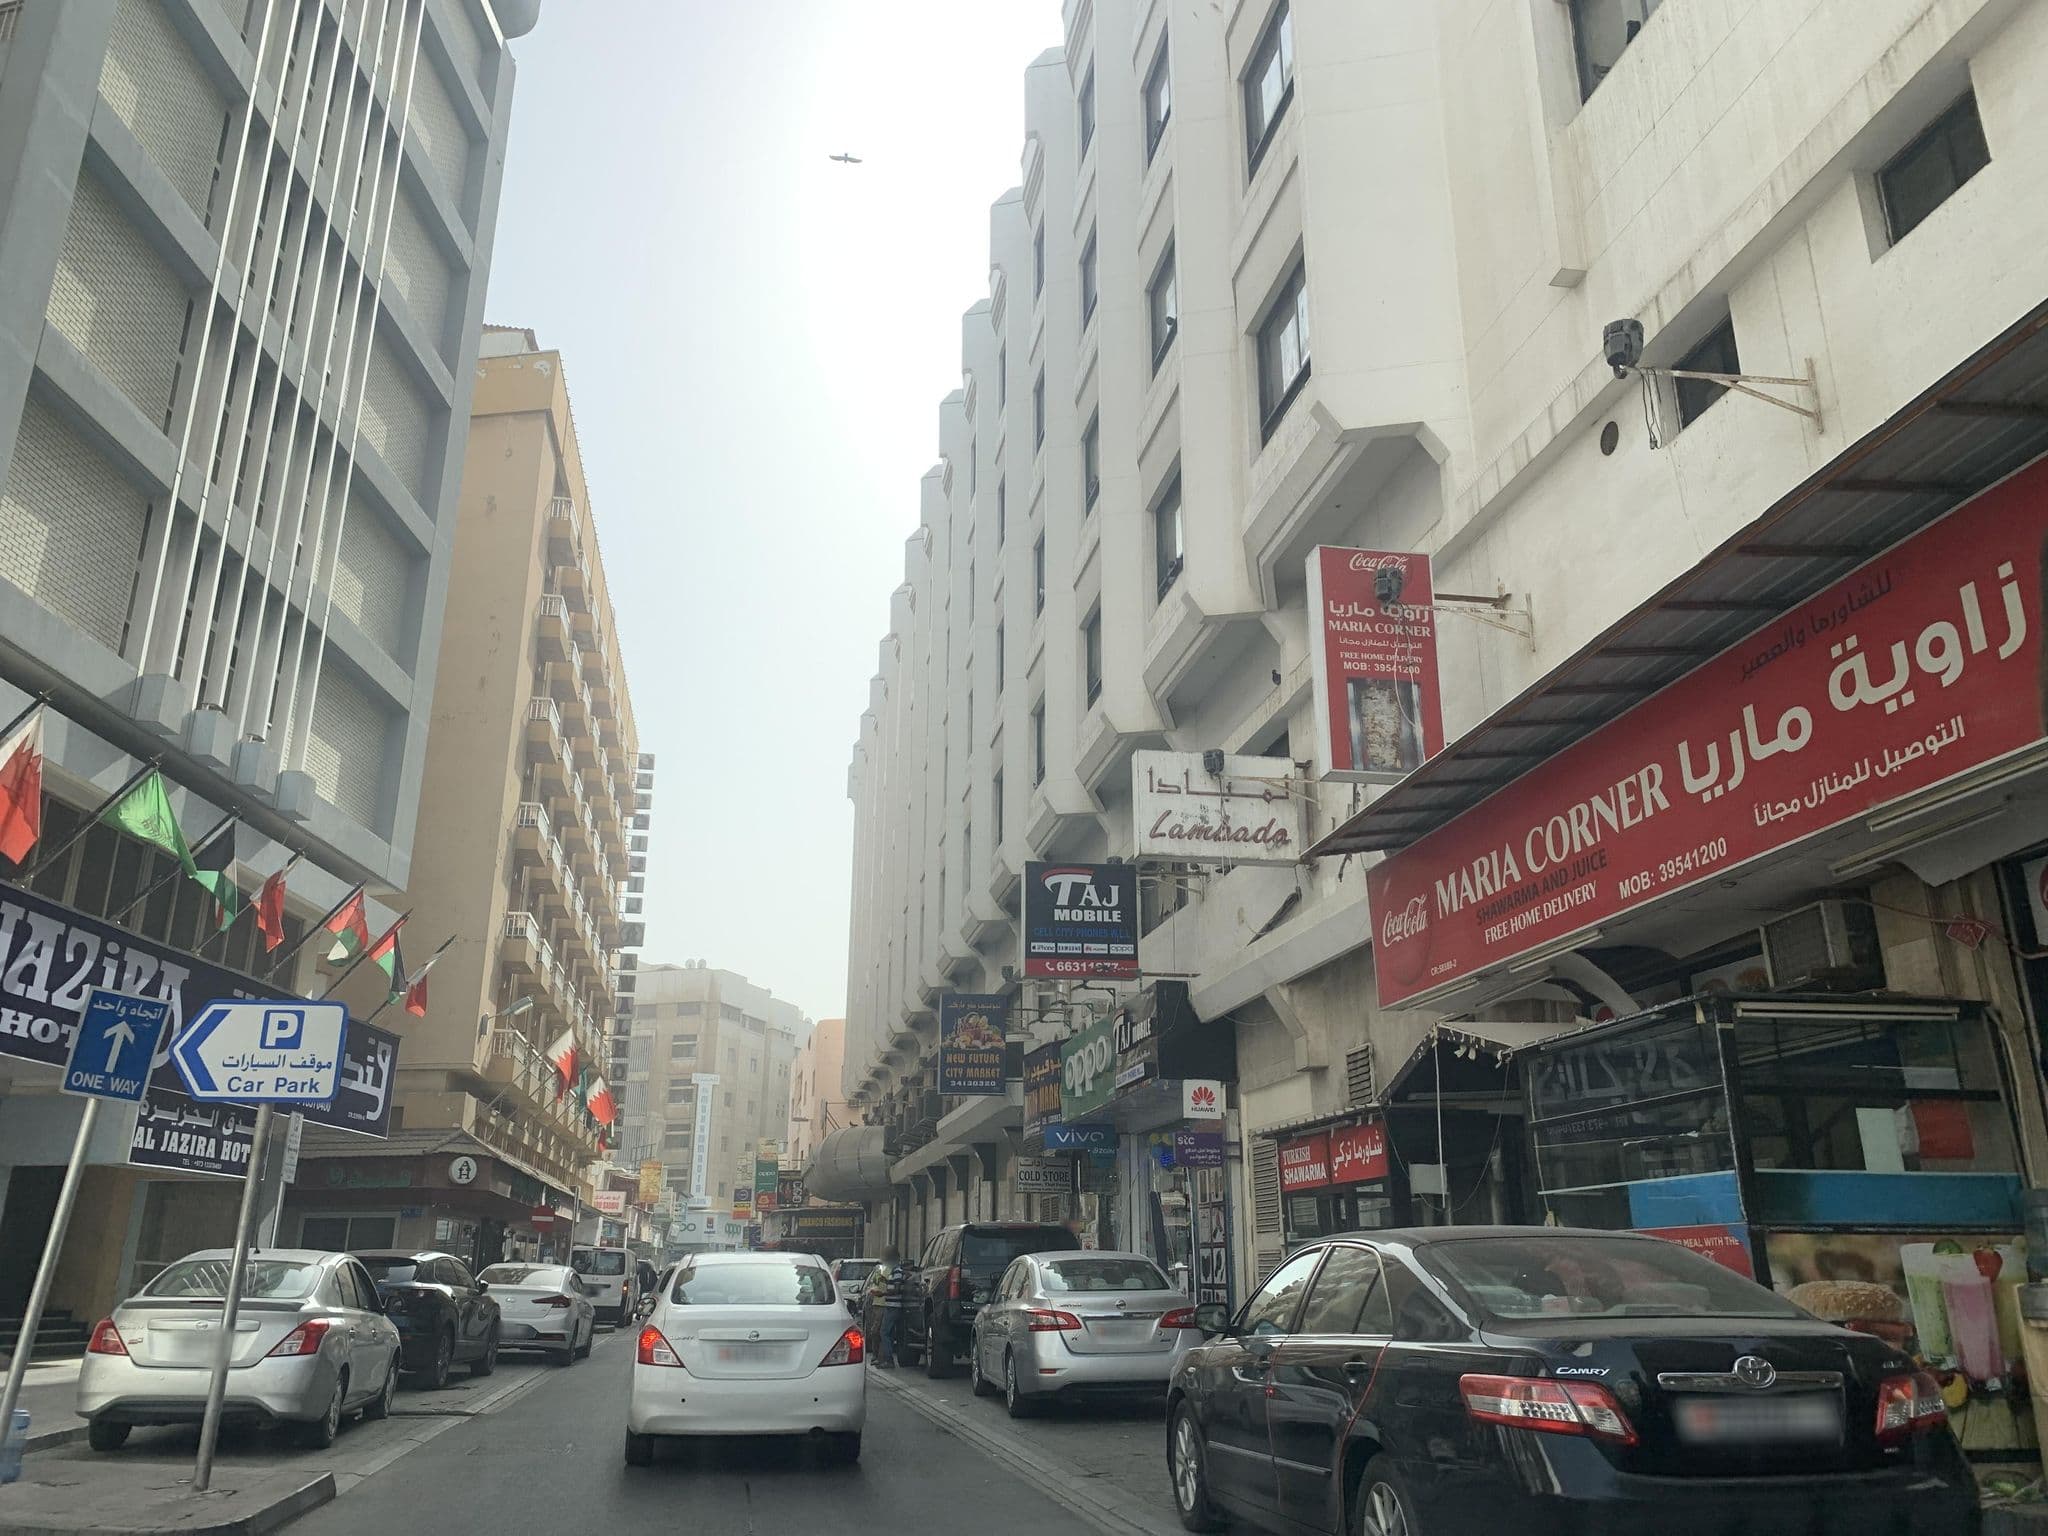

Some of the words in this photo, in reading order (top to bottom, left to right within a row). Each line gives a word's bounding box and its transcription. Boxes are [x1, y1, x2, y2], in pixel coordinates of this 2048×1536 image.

[1329, 600, 1375, 617] ماريا
[1328, 620, 1372, 633] MARIA
[1375, 622, 1431, 637] CORNER
[1827, 560, 2027, 715] زاوية
[1340, 651, 1360, 659] FREE
[1361, 652, 1384, 660] HOME
[1386, 653, 1423, 663] DELIVERY
[1343, 661, 1371, 671] MOB:
[1374, 663, 1420, 674] 39541200
[1677, 702, 1814, 803] ماريا
[1874, 714, 1966, 777] التوصيل
[1803, 758, 1870, 808] للمنازل
[1434, 842, 1522, 920] MARIA
[1525, 762, 1670, 874] CORNER
[1618, 871, 1656, 899] MOB:
[1658, 836, 1728, 882] 39541200
[1044, 873, 1120, 907] TAJ
[1476, 882, 1540, 926] SHAWARMA
[1542, 871, 1568, 894] AND
[1572, 849, 1608, 881] JUICE
[1053, 908, 1122, 923] MOBILE
[1484, 922, 1509, 944] FREE
[1510, 906, 1544, 934] HOME
[1543, 880, 1597, 920] DELIVERY
[93, 999, 127, 1017] واحد
[130, 1003, 164, 1020] اتجاه
[265, 1012, 299, 1047] P
[222, 1053, 286, 1072] السيارات
[289, 1053, 333, 1073] موقف
[969, 1053, 1000, 1063] FUTURE
[945, 1067, 963, 1078] CITY
[966, 1067, 1000, 1078] MARKET
[71, 1071, 105, 1089] ONE
[110, 1076, 140, 1095] WAY
[227, 1076, 265, 1093] Car
[274, 1076, 320, 1093] Park
[132, 1126, 157, 1150] AL
[160, 1129, 217, 1159] JAZIRA
[1055, 1128, 1105, 1143] vivo
[1177, 1134, 1195, 1145] stc
[1283, 1145, 1311, 1166] TURKISH
[1353, 1129, 1383, 1165] شاورما
[1332, 1141, 1352, 1177] تركي
[1018, 1170, 1041, 1182] COLD
[1042, 1170, 1070, 1182] STORE
[1284, 1162, 1327, 1185] SHAWARMA
[1683, 1238, 1703, 1248] MEAL
[1703, 1236, 1724, 1247] WITH
[1723, 1236, 1740, 1246] THE
[1555, 1366, 1610, 1376] CAMRY
